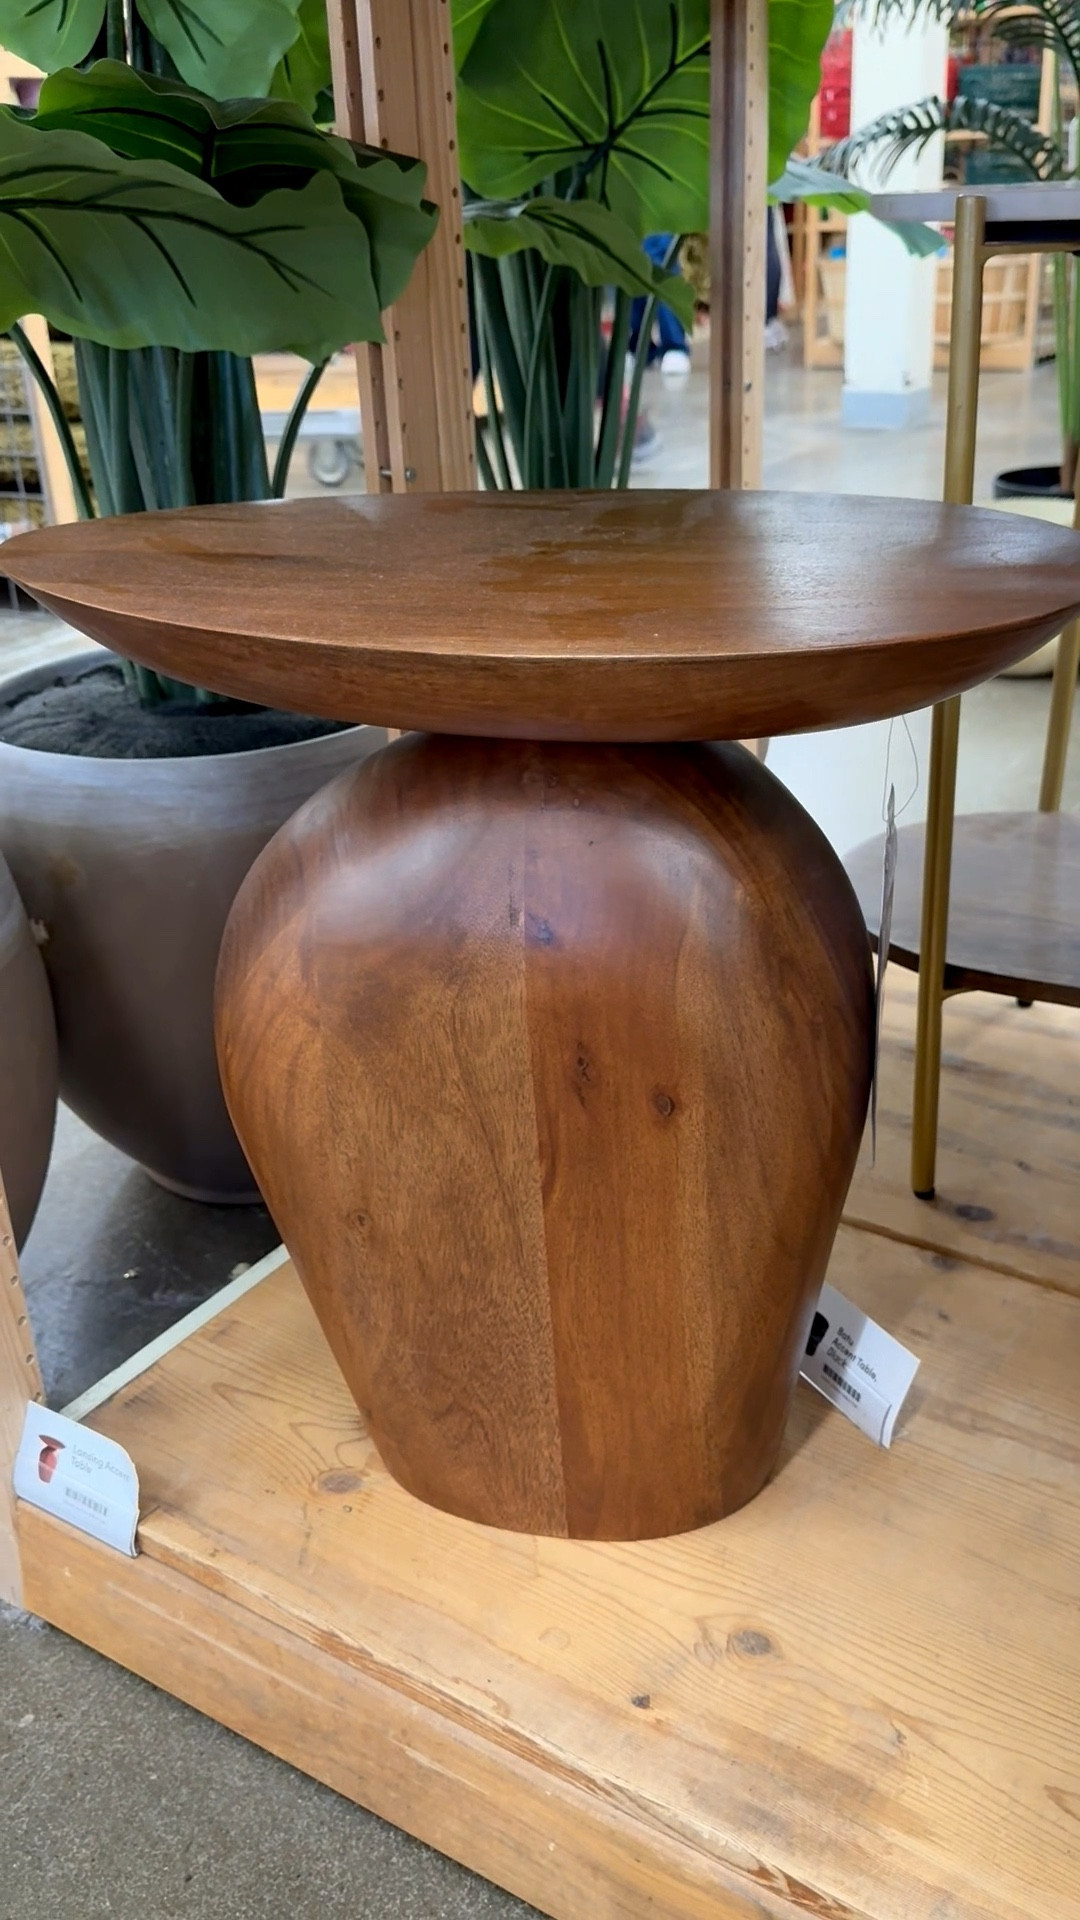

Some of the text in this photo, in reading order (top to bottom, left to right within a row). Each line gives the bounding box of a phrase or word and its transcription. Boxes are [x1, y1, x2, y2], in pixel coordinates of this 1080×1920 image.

[832, 1337, 877, 1383] Accent Table,
[72, 1455, 93, 1474] Table
[104, 1461, 130, 1482] Accent
